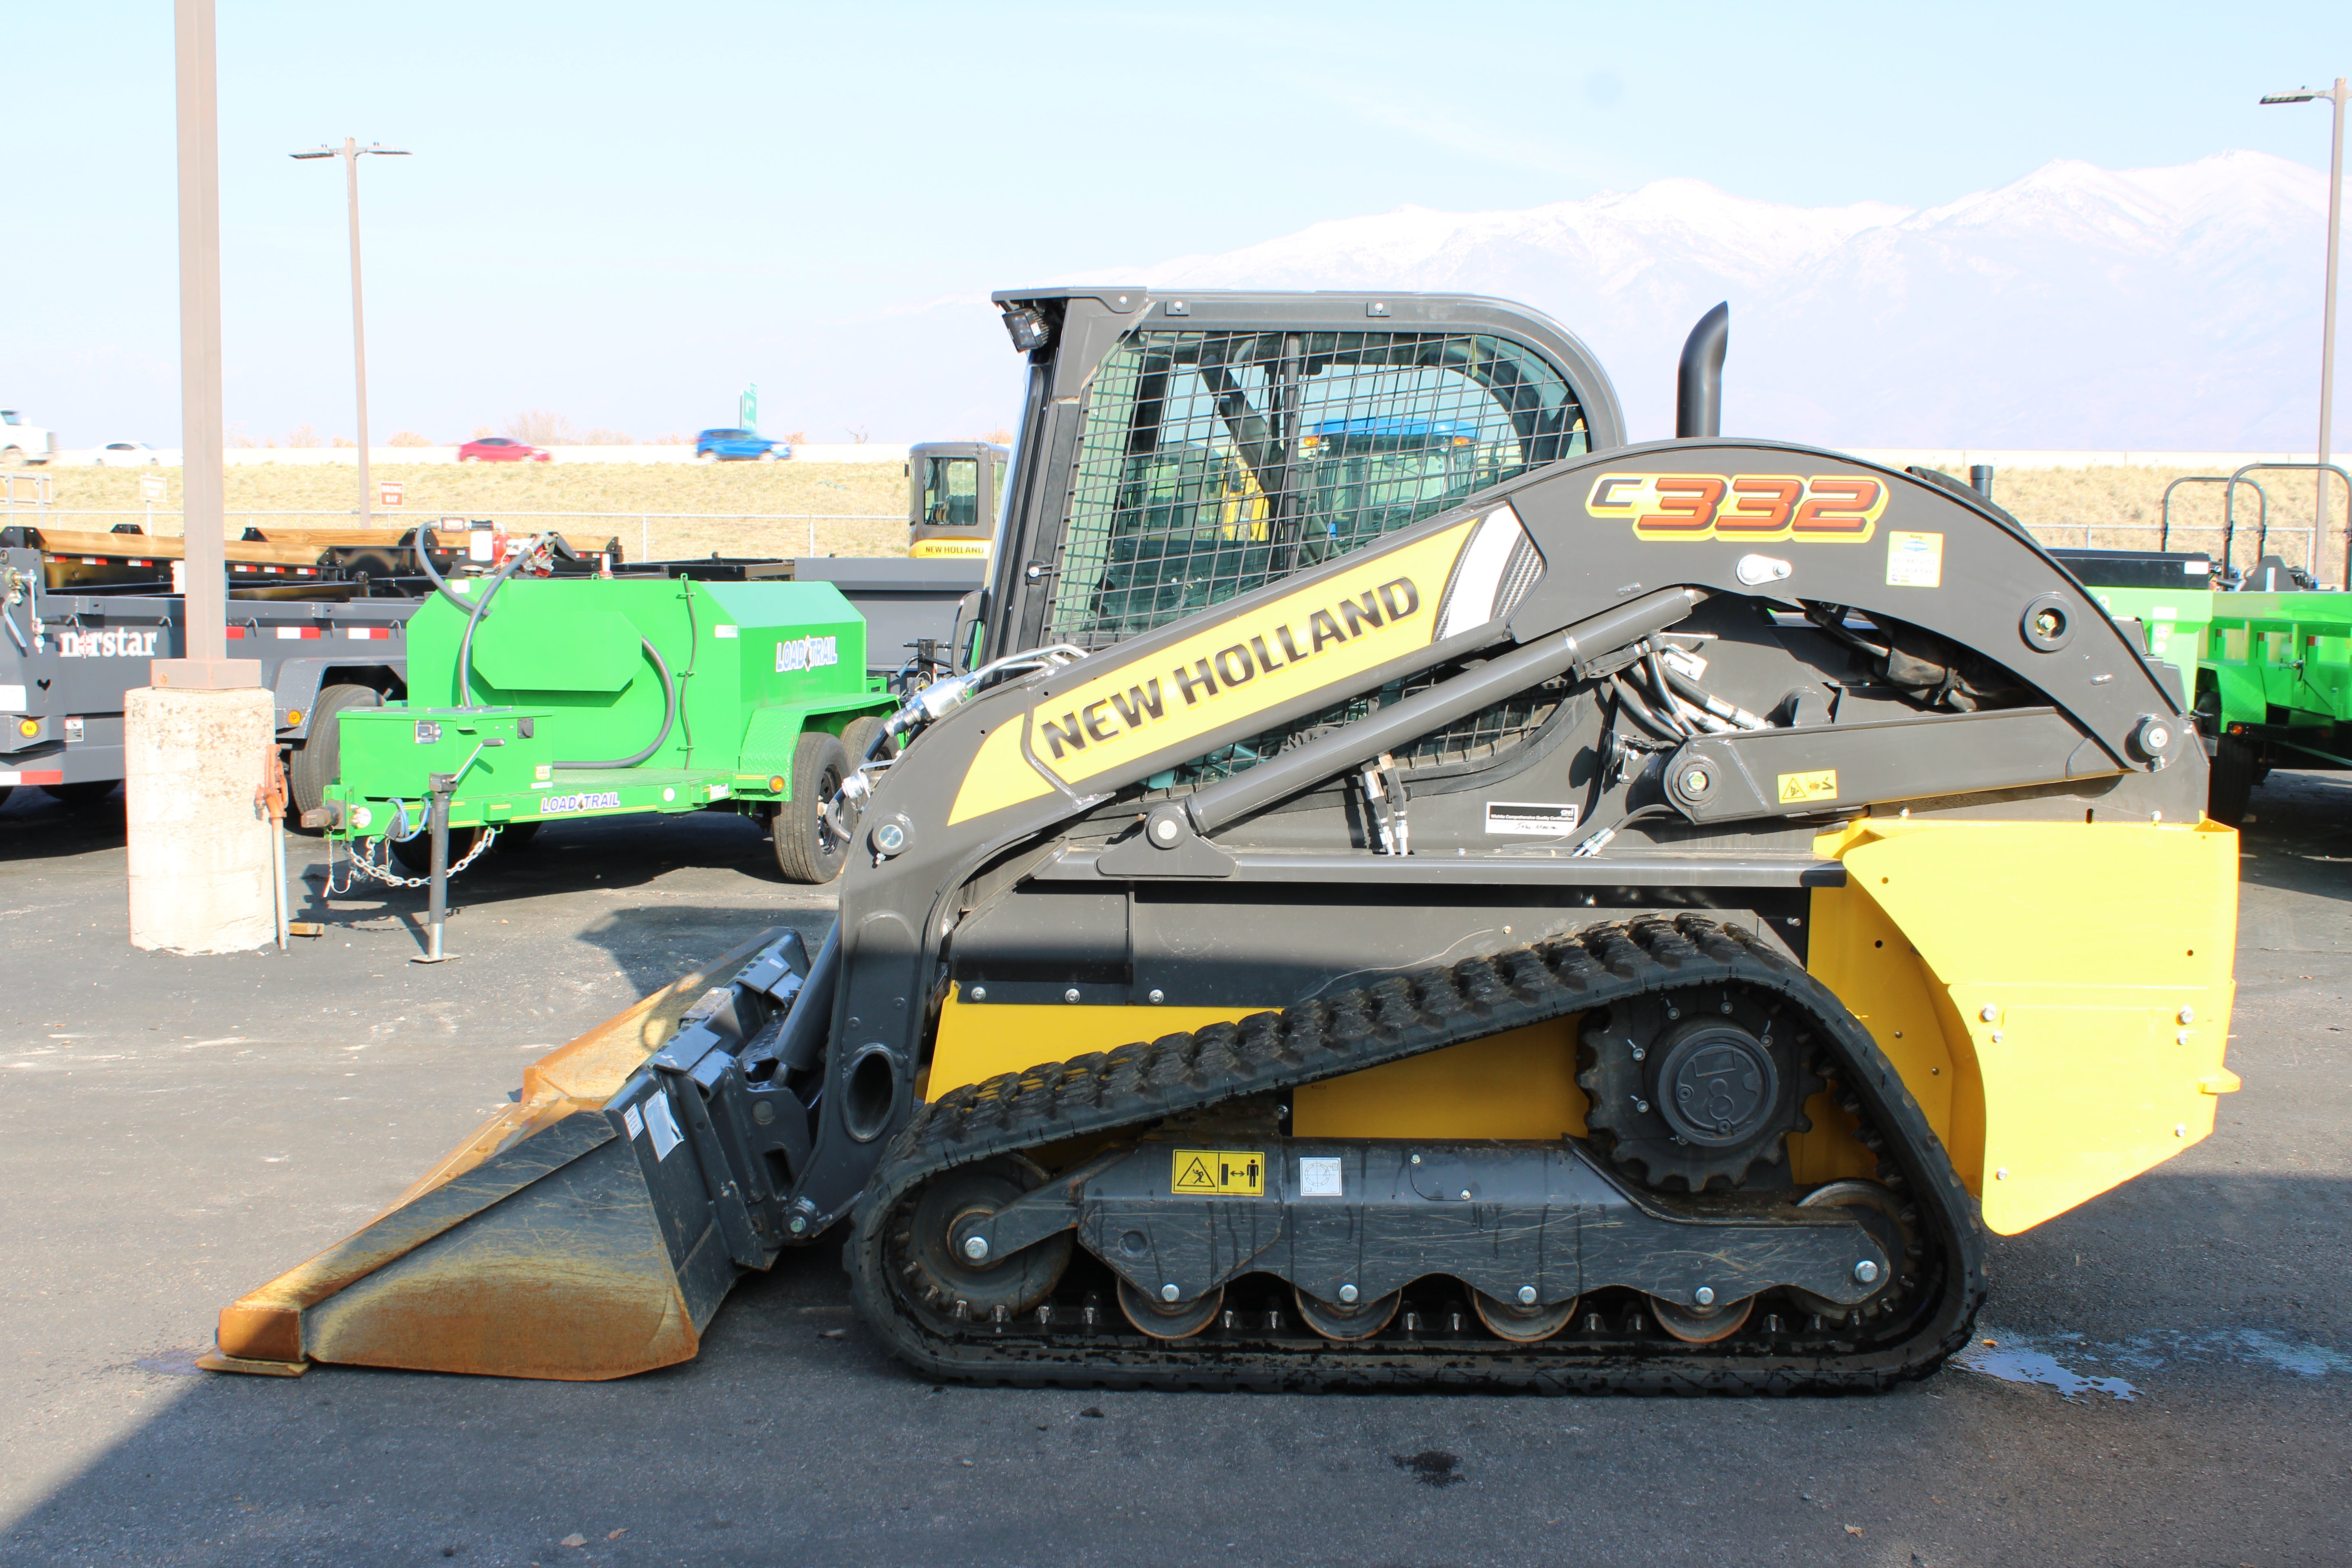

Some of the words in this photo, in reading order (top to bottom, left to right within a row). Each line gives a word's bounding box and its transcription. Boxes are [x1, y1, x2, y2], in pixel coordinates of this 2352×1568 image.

[381, 485, 402, 493] WRONG
[385, 495, 398, 503] WAY
[777, 639, 805, 671] LOAD
[809, 636, 837, 667] TRAIL
[1040, 677, 1165, 761] NEW
[1173, 576, 1420, 706] HOLLAND
[542, 796, 577, 812] LOAD
[584, 793, 620, 808] TRAIL
